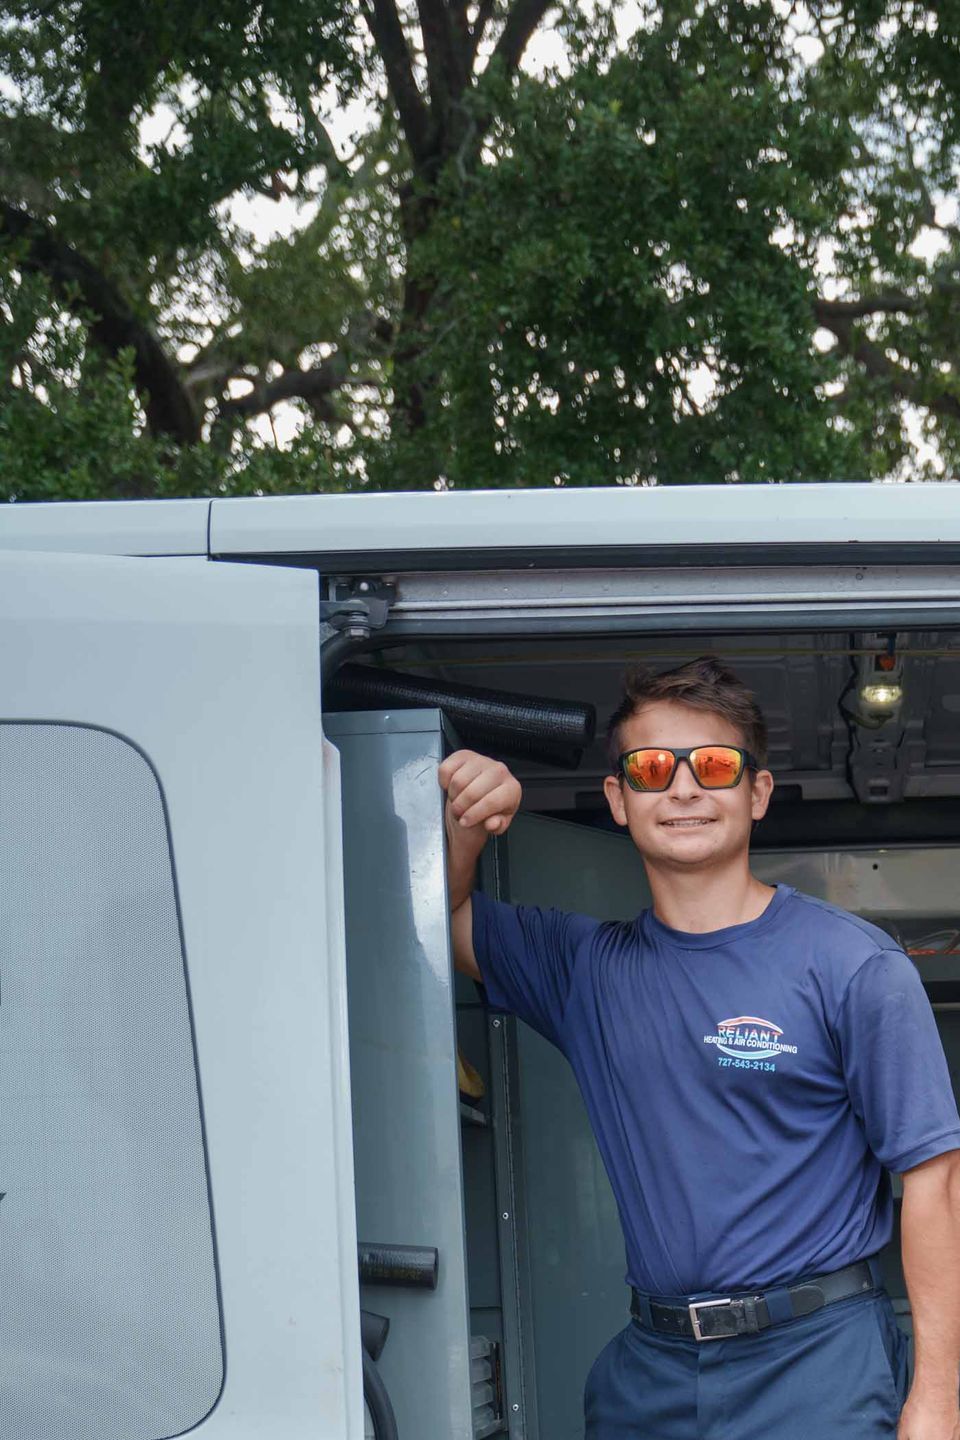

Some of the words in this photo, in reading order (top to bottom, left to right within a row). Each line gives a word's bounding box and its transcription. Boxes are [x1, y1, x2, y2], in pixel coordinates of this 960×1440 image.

[718, 1026, 781, 1043] RELIANT
[703, 1035, 727, 1045] HEATING
[734, 1039, 746, 1047] AIR
[746, 1039, 798, 1054] CONDITIONING
[718, 1057, 776, 1072] 727-543-2134
